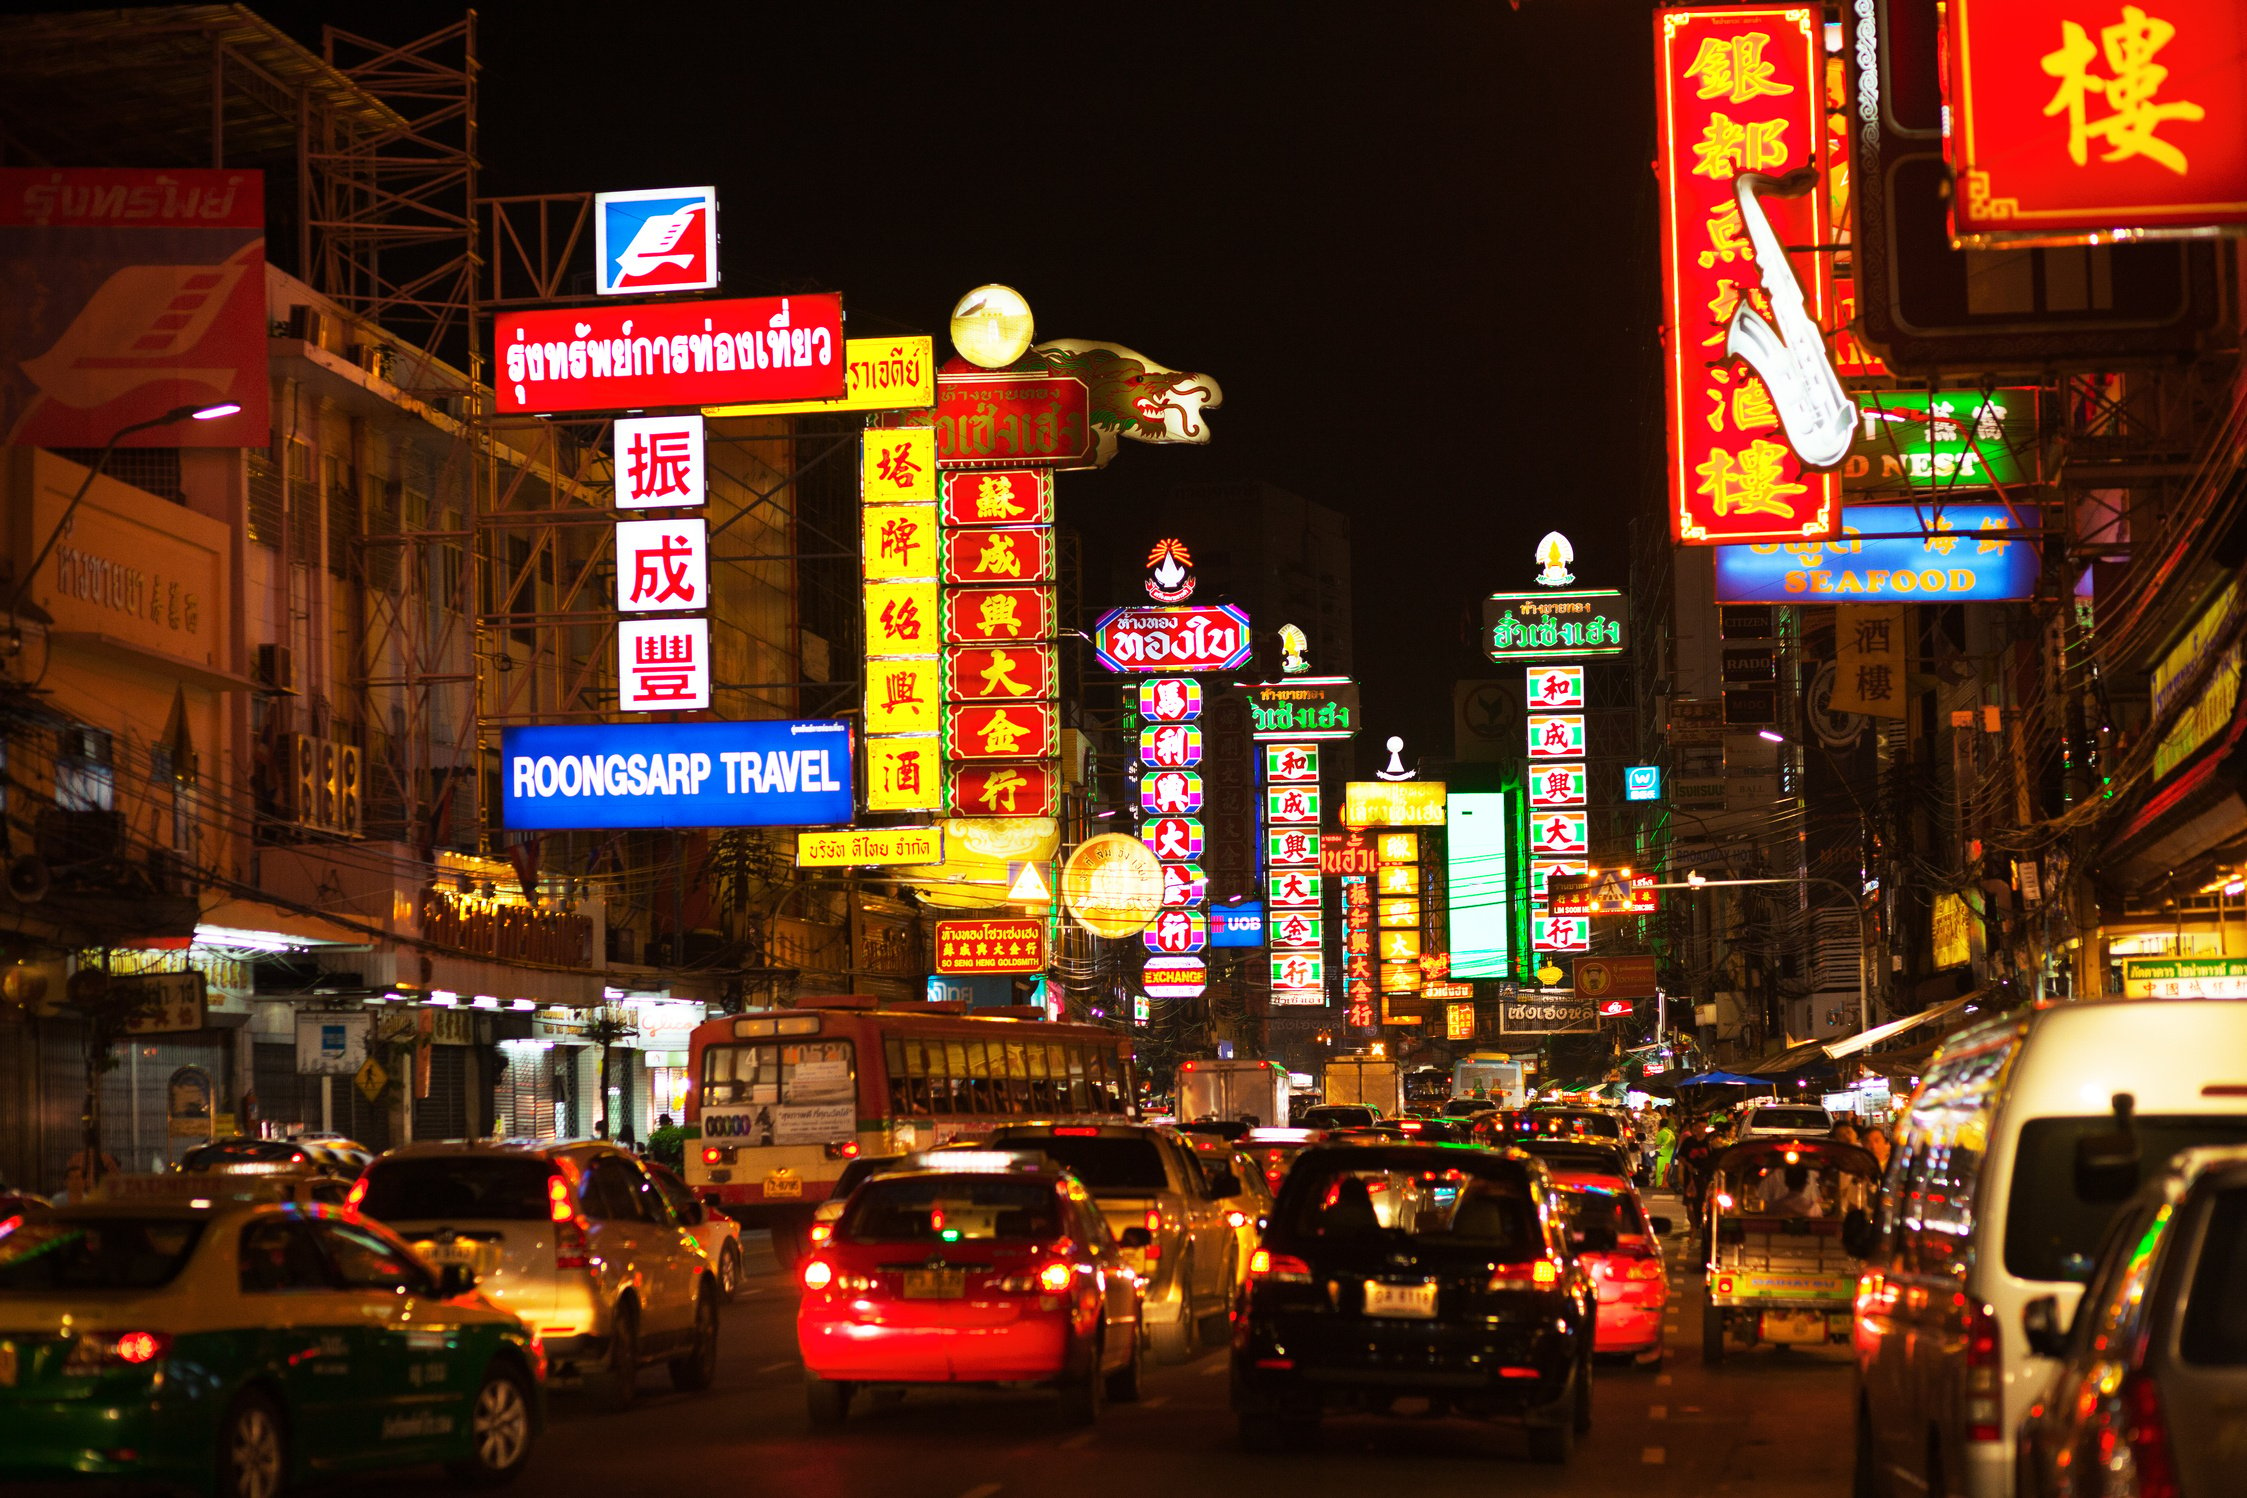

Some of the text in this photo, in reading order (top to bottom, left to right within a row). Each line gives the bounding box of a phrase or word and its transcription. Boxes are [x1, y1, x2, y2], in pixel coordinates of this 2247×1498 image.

[2042, 5, 2204, 175] 樓
[507, 298, 831, 405] รุ่งทรัพย์การท่องเที่ยว
[1881, 451, 1980, 478] NEST
[627, 431, 697, 701] 振成豐
[1784, 569, 1976, 593] SEAFOOD
[1117, 613, 1178, 630] ห้างทอง
[1725, 616, 1769, 628] CITIZEN
[1113, 616, 1236, 661] ทองใบ
[1727, 658, 1771, 669] RADO
[513, 750, 840, 798] ROONGSARP TRAVEL
[1544, 675, 1574, 945] 和成興大行
[810, 840, 845, 859] บริษัท
[896, 837, 930, 856] จำกัด
[1281, 752, 1309, 984] 和成興大金行
[1227, 916, 1262, 931] UOB
[942, 958, 1039, 967] SO SENG HENG GOLDSMITH
[1144, 971, 1204, 983] EXCHANGE
